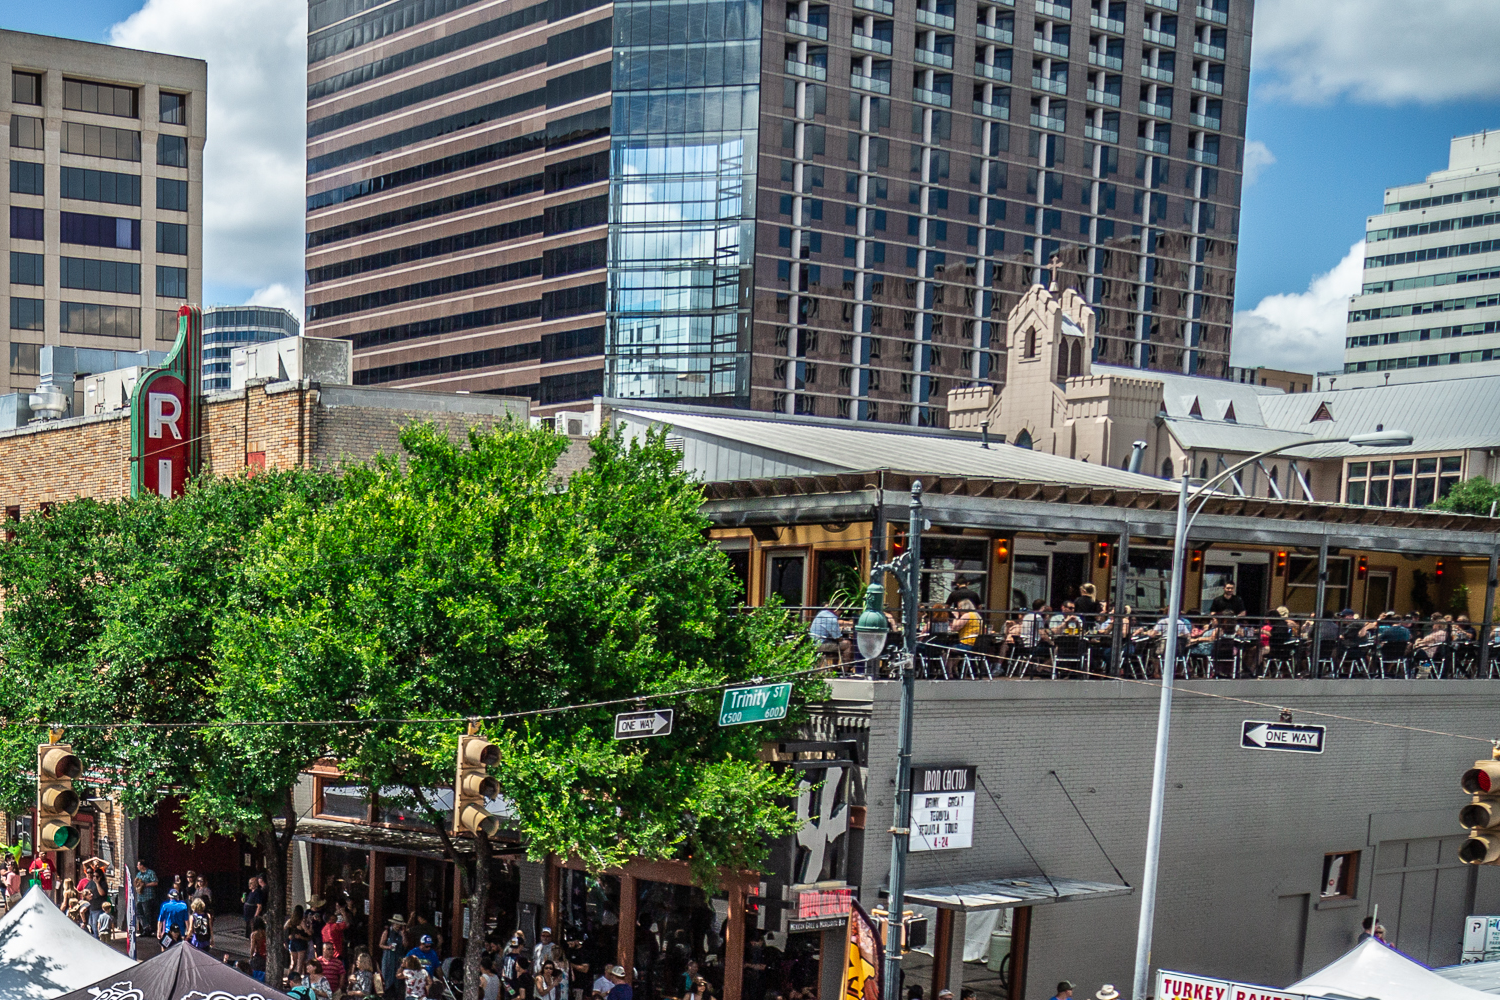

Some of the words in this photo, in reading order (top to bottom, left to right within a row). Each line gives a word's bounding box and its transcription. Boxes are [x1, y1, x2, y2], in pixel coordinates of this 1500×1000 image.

[731, 689, 770, 708] Trinity
[773, 686, 784, 698] ST
[727, 712, 742, 723] 500
[765, 707, 779, 718] 600
[622, 721, 636, 731] ONE
[640, 719, 655, 729] WAY
[1266, 731, 1288, 742] ONE
[1292, 733, 1315, 744] WAY
[924, 770, 941, 791] IRON
[943, 769, 967, 790] CACTUS
